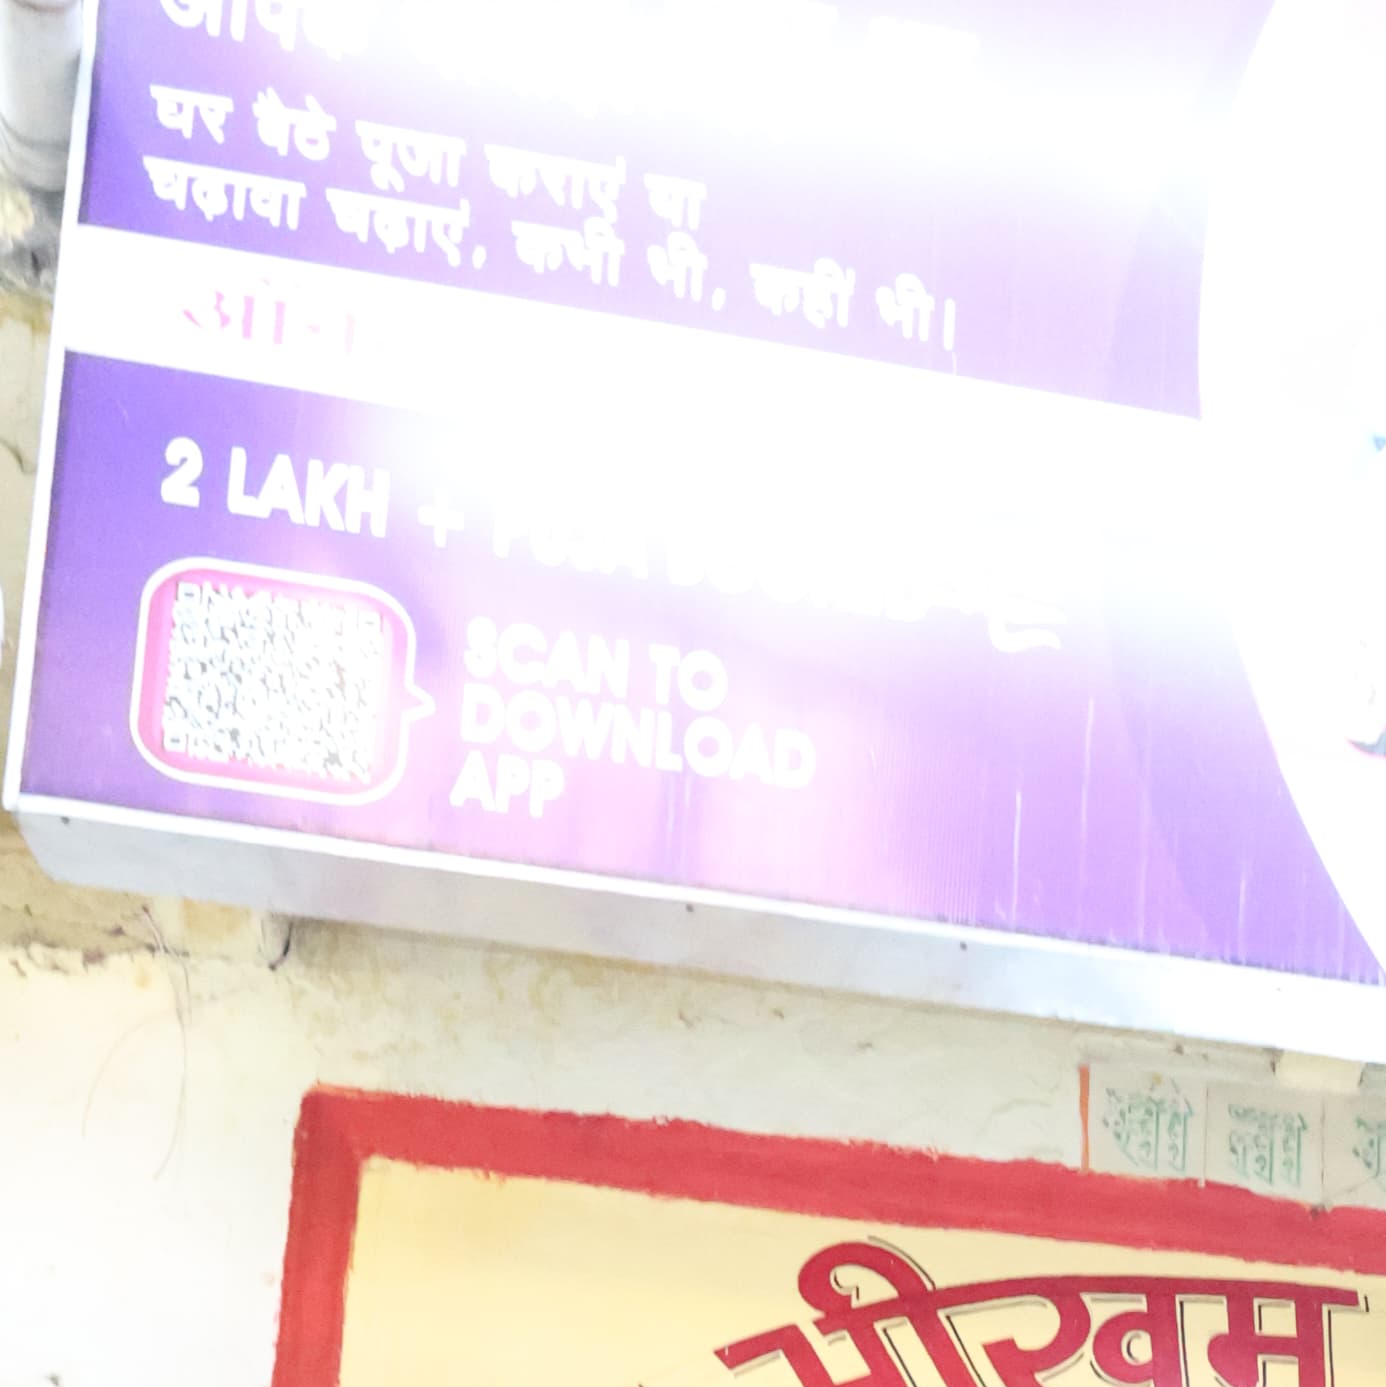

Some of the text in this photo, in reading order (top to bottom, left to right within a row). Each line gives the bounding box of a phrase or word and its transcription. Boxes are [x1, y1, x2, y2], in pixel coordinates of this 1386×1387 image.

[356, 119, 466, 193] पूजा
[512, 216, 625, 287] कभी
[161, 437, 203, 507] 2
[228, 447, 391, 537] LAKH
[463, 616, 729, 711] SCAN TO
[460, 682, 816, 789] DOWNLOAD
[449, 750, 565, 819] APP
